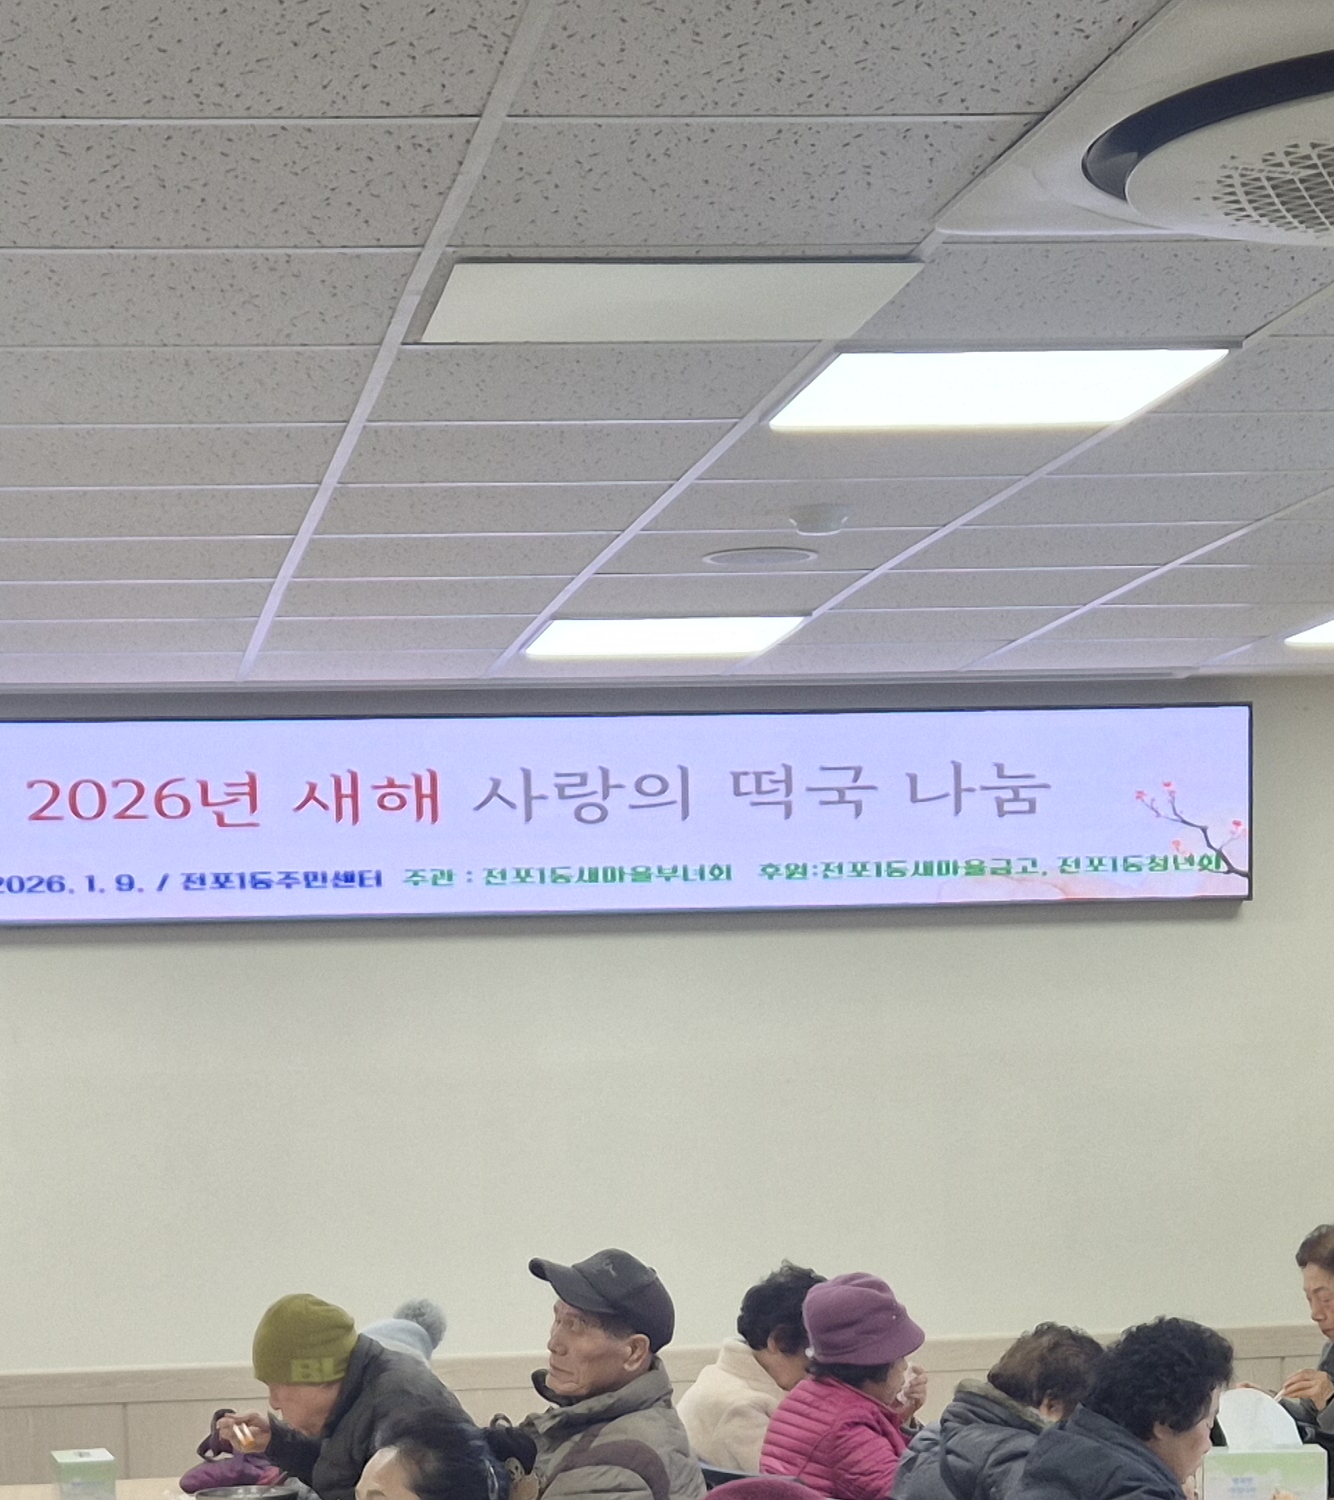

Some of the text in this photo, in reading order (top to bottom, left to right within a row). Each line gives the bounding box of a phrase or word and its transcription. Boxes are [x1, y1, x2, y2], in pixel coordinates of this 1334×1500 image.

[25, 758, 1053, 829] 2026년 새해 사랑의 떡국 나눔
